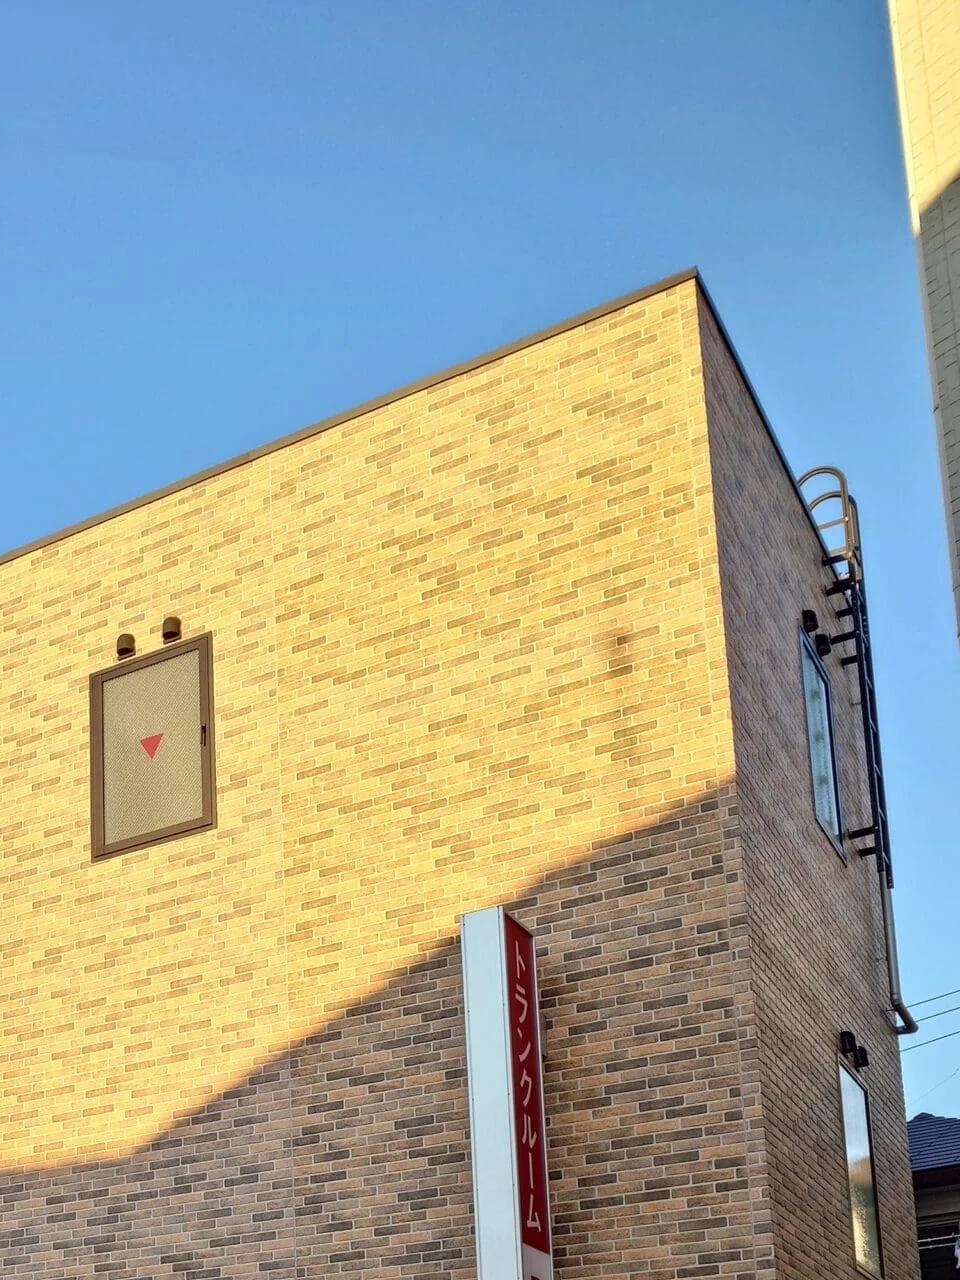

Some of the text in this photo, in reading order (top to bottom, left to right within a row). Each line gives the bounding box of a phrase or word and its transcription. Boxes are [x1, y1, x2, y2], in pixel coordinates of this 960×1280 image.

[515, 940, 541, 1232] トランクルーム
